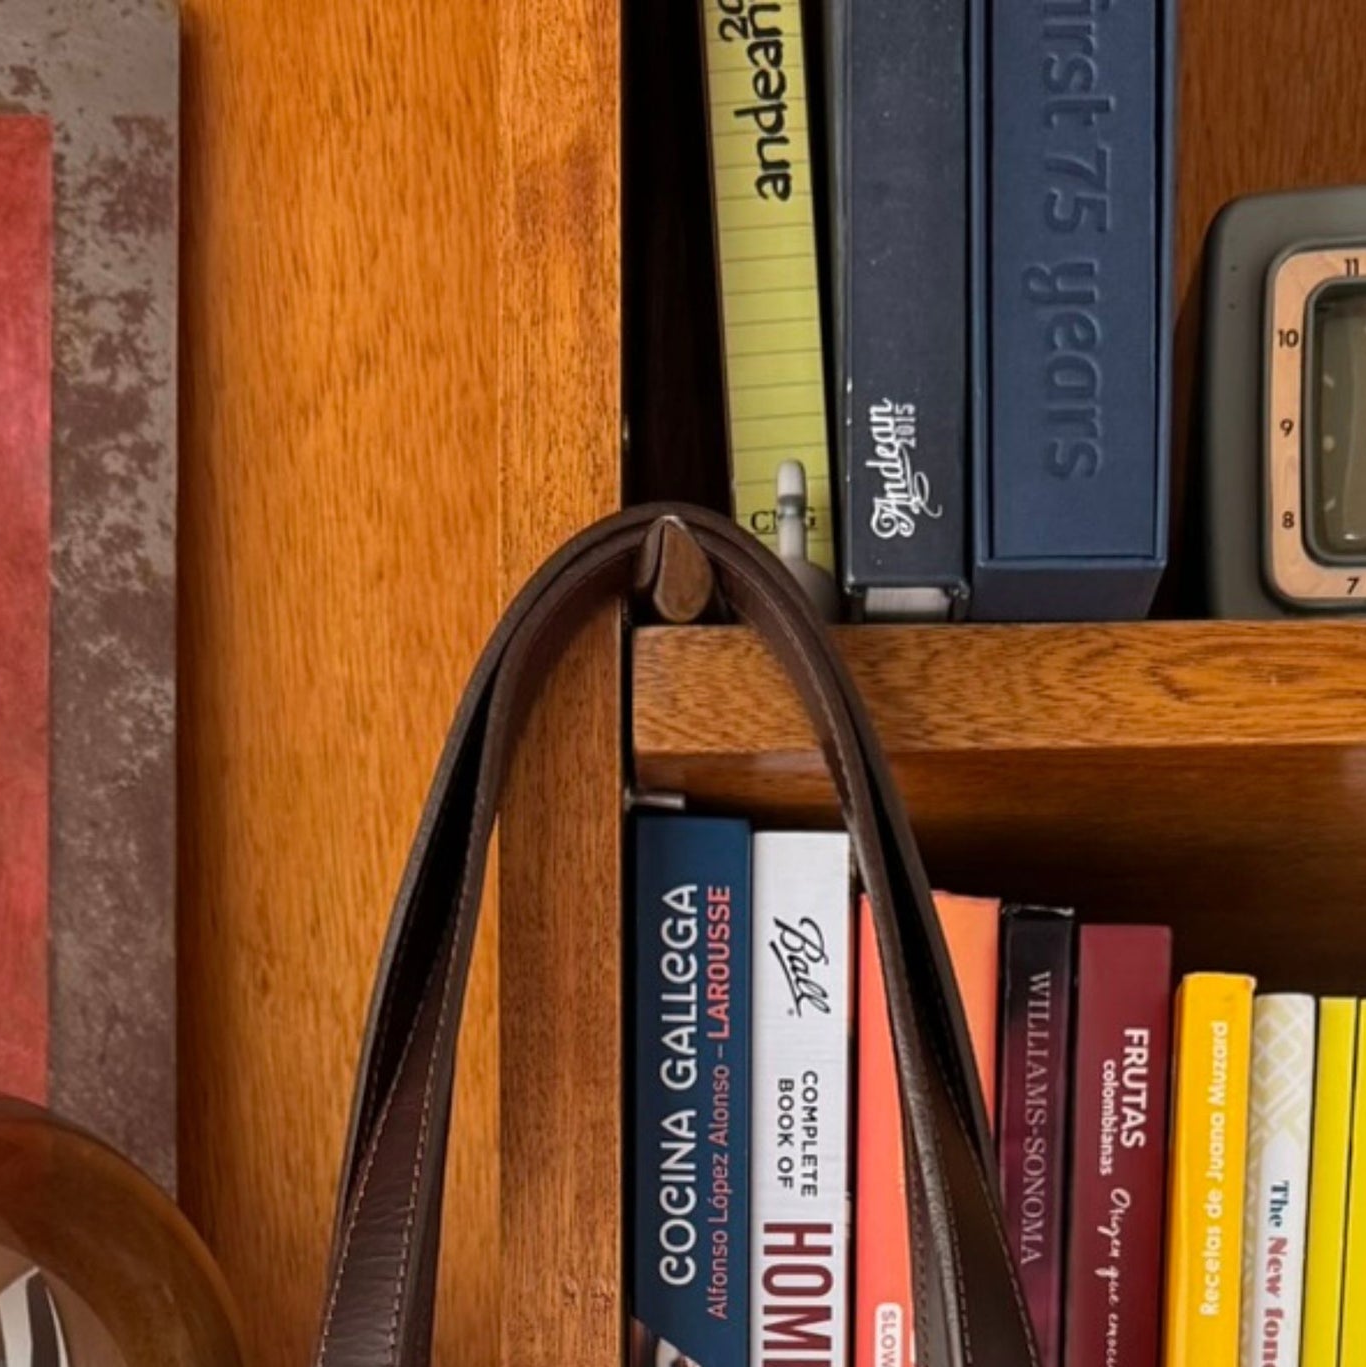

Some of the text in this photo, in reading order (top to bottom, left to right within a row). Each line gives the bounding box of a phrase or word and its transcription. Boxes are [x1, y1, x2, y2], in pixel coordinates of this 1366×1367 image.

[734, 3, 792, 202] andean
[1043, 145, 1111, 234] 75
[1344, 258, 1360, 278] 11
[1021, 258, 1103, 481] years
[1277, 328, 1300, 348] 10
[865, 397, 943, 538] Andean
[894, 403, 917, 448] 2015
[1280, 419, 1294, 438] 9
[1282, 511, 1295, 529] 8
[1346, 577, 1360, 596] 7
[705, 884, 733, 1320] Alfonso López Alonso LAROUSSE
[776, 1077, 796, 1191] BOOK OF
[800, 1070, 819, 1198] COMPLETE
[1020, 970, 1052, 1266] WILLIAMS-SONOMA
[1099, 1059, 1116, 1177] colombianas
[1119, 1028, 1149, 1149] FRUTAS
[659, 1108, 698, 1286] COCINA
[1199, 1020, 1230, 1318] Recetas de Juana Muzard
[1269, 1179, 1291, 1229] The
[1096, 1186, 1131, 1258] Origen
[1265, 1235, 1288, 1299] New
[1094, 1263, 1121, 1308] que
